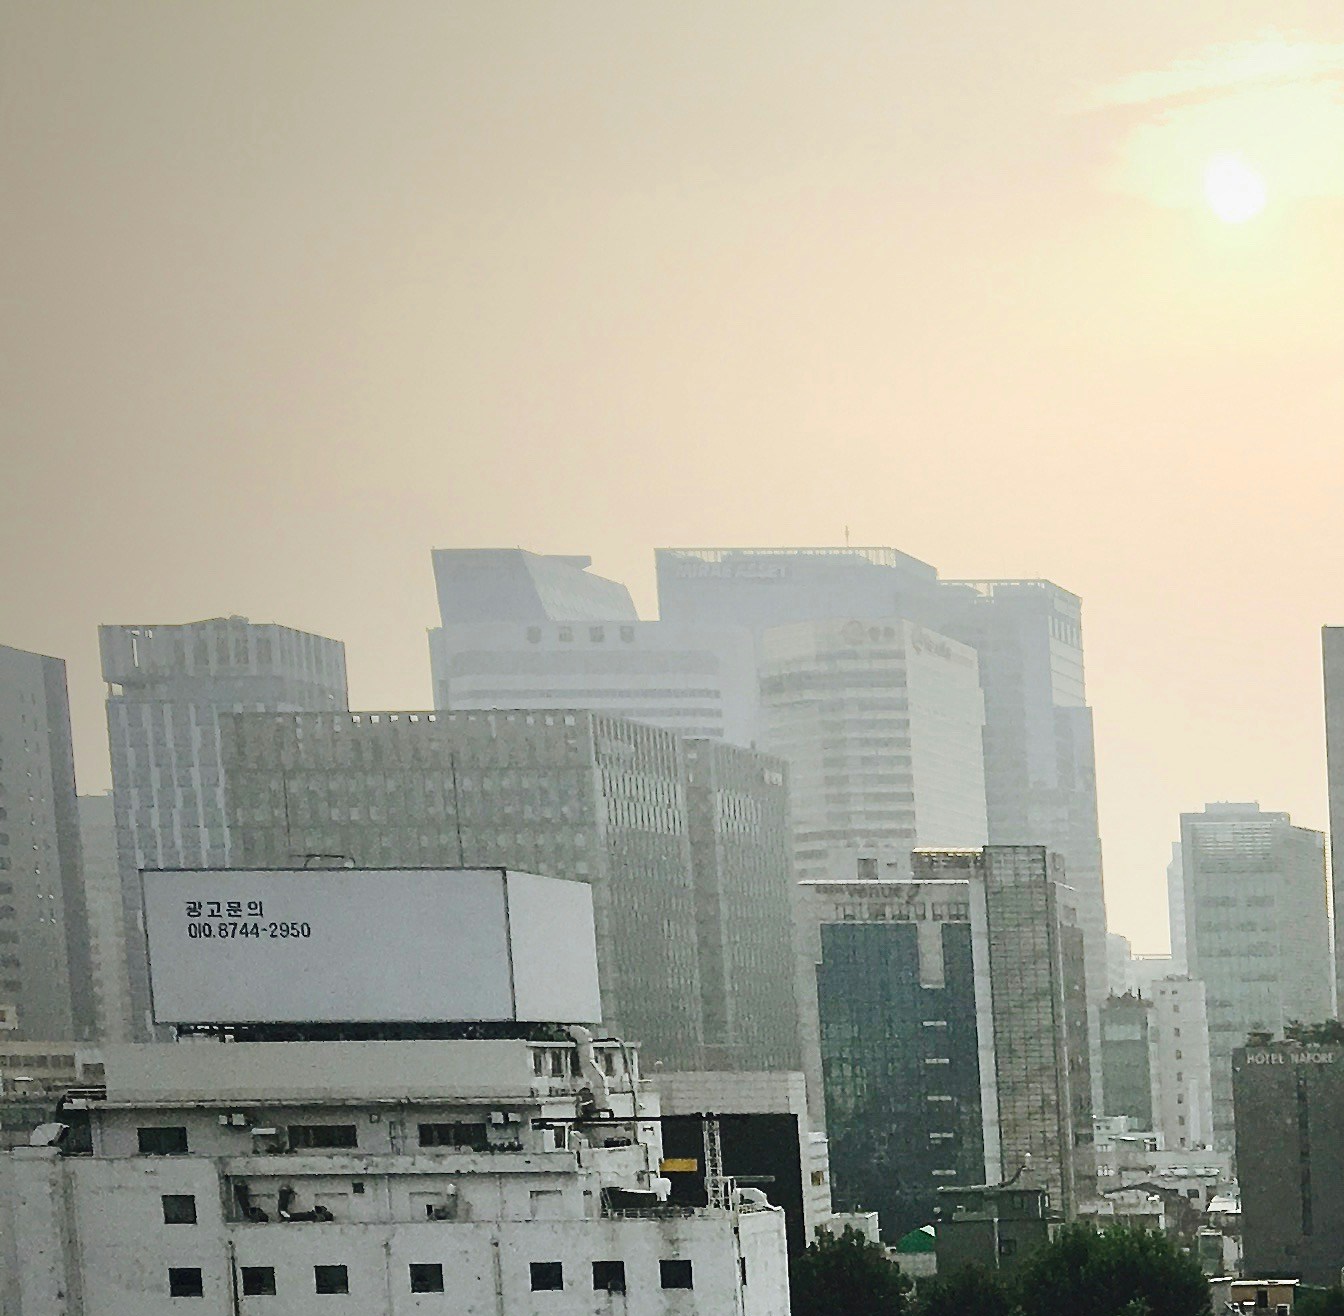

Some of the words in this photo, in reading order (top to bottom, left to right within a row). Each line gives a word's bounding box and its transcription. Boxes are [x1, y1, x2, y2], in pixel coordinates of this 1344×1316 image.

[185, 900, 264, 918] 광고문의
[187, 922, 312, 939] 010.8744-2950
[1246, 1053, 1285, 1065] HOTEL
